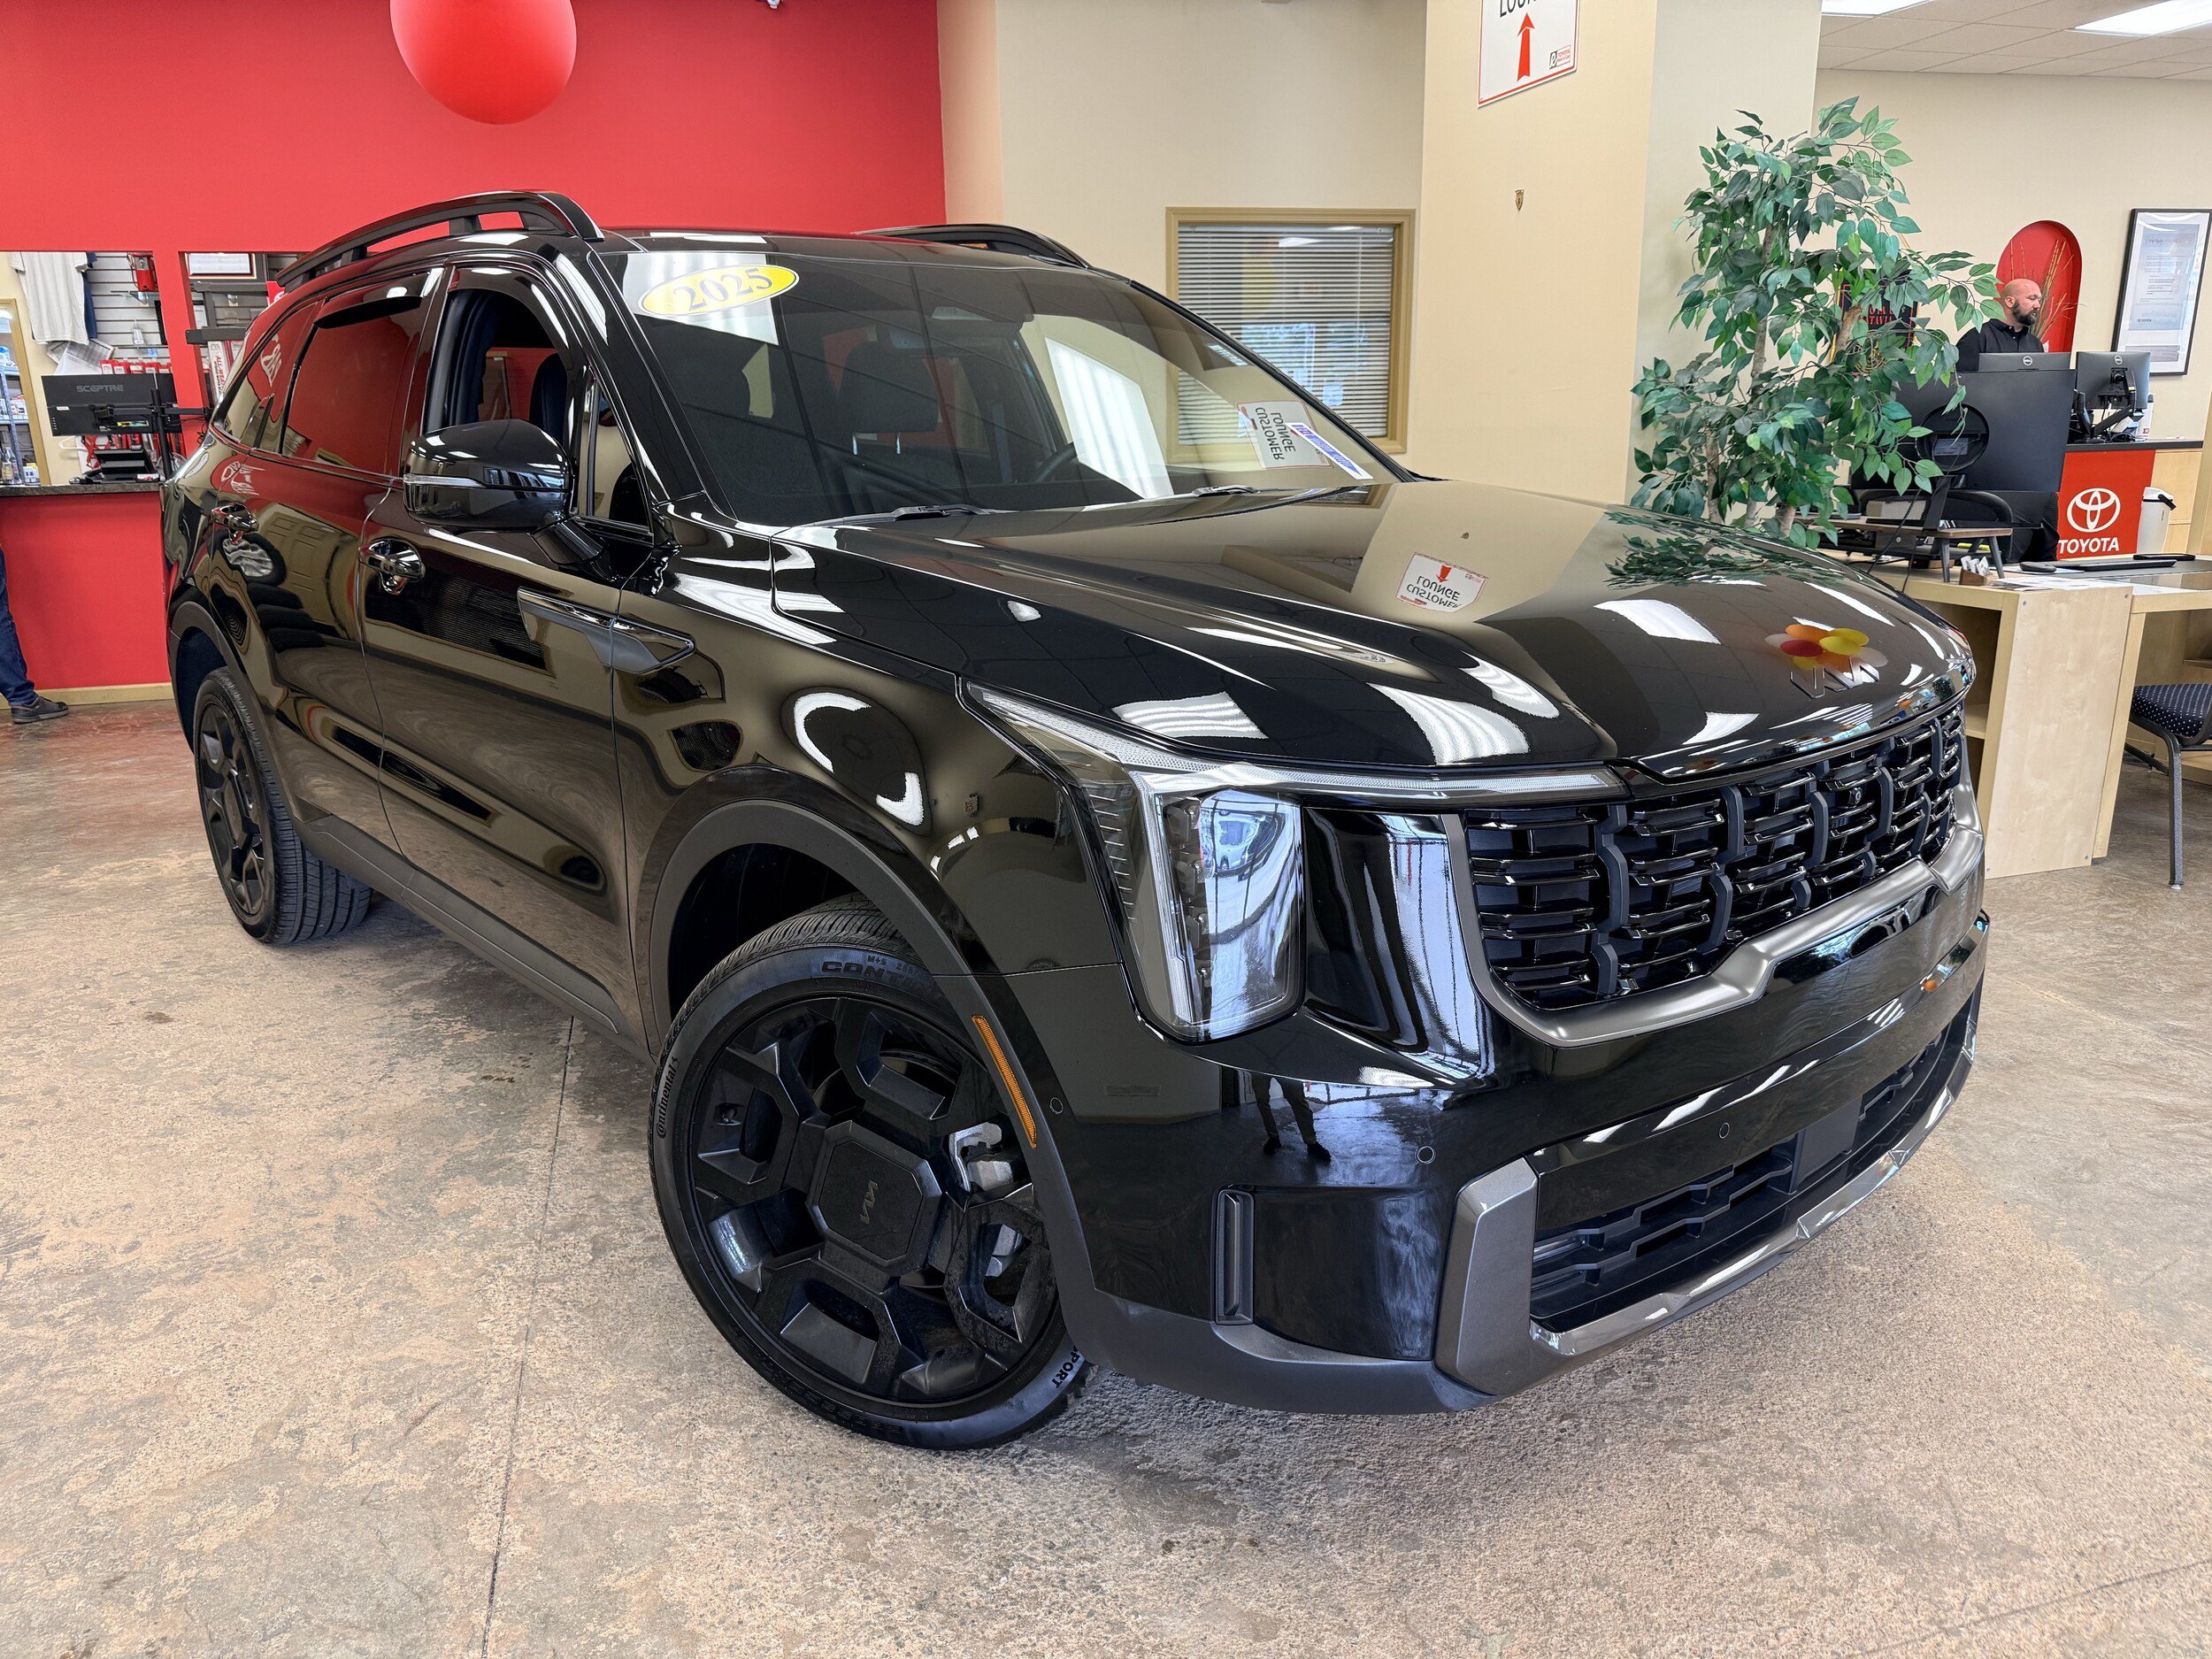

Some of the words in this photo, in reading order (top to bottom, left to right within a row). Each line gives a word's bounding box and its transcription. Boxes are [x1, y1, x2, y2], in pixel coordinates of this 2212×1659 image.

[673, 267, 772, 311] 2025
[76, 384, 124, 393] SCEPTRE
[2058, 537, 2120, 554] TOYOTA
[657, 1064, 677, 1139] Continental
[1050, 1345, 1081, 1389] PORT
